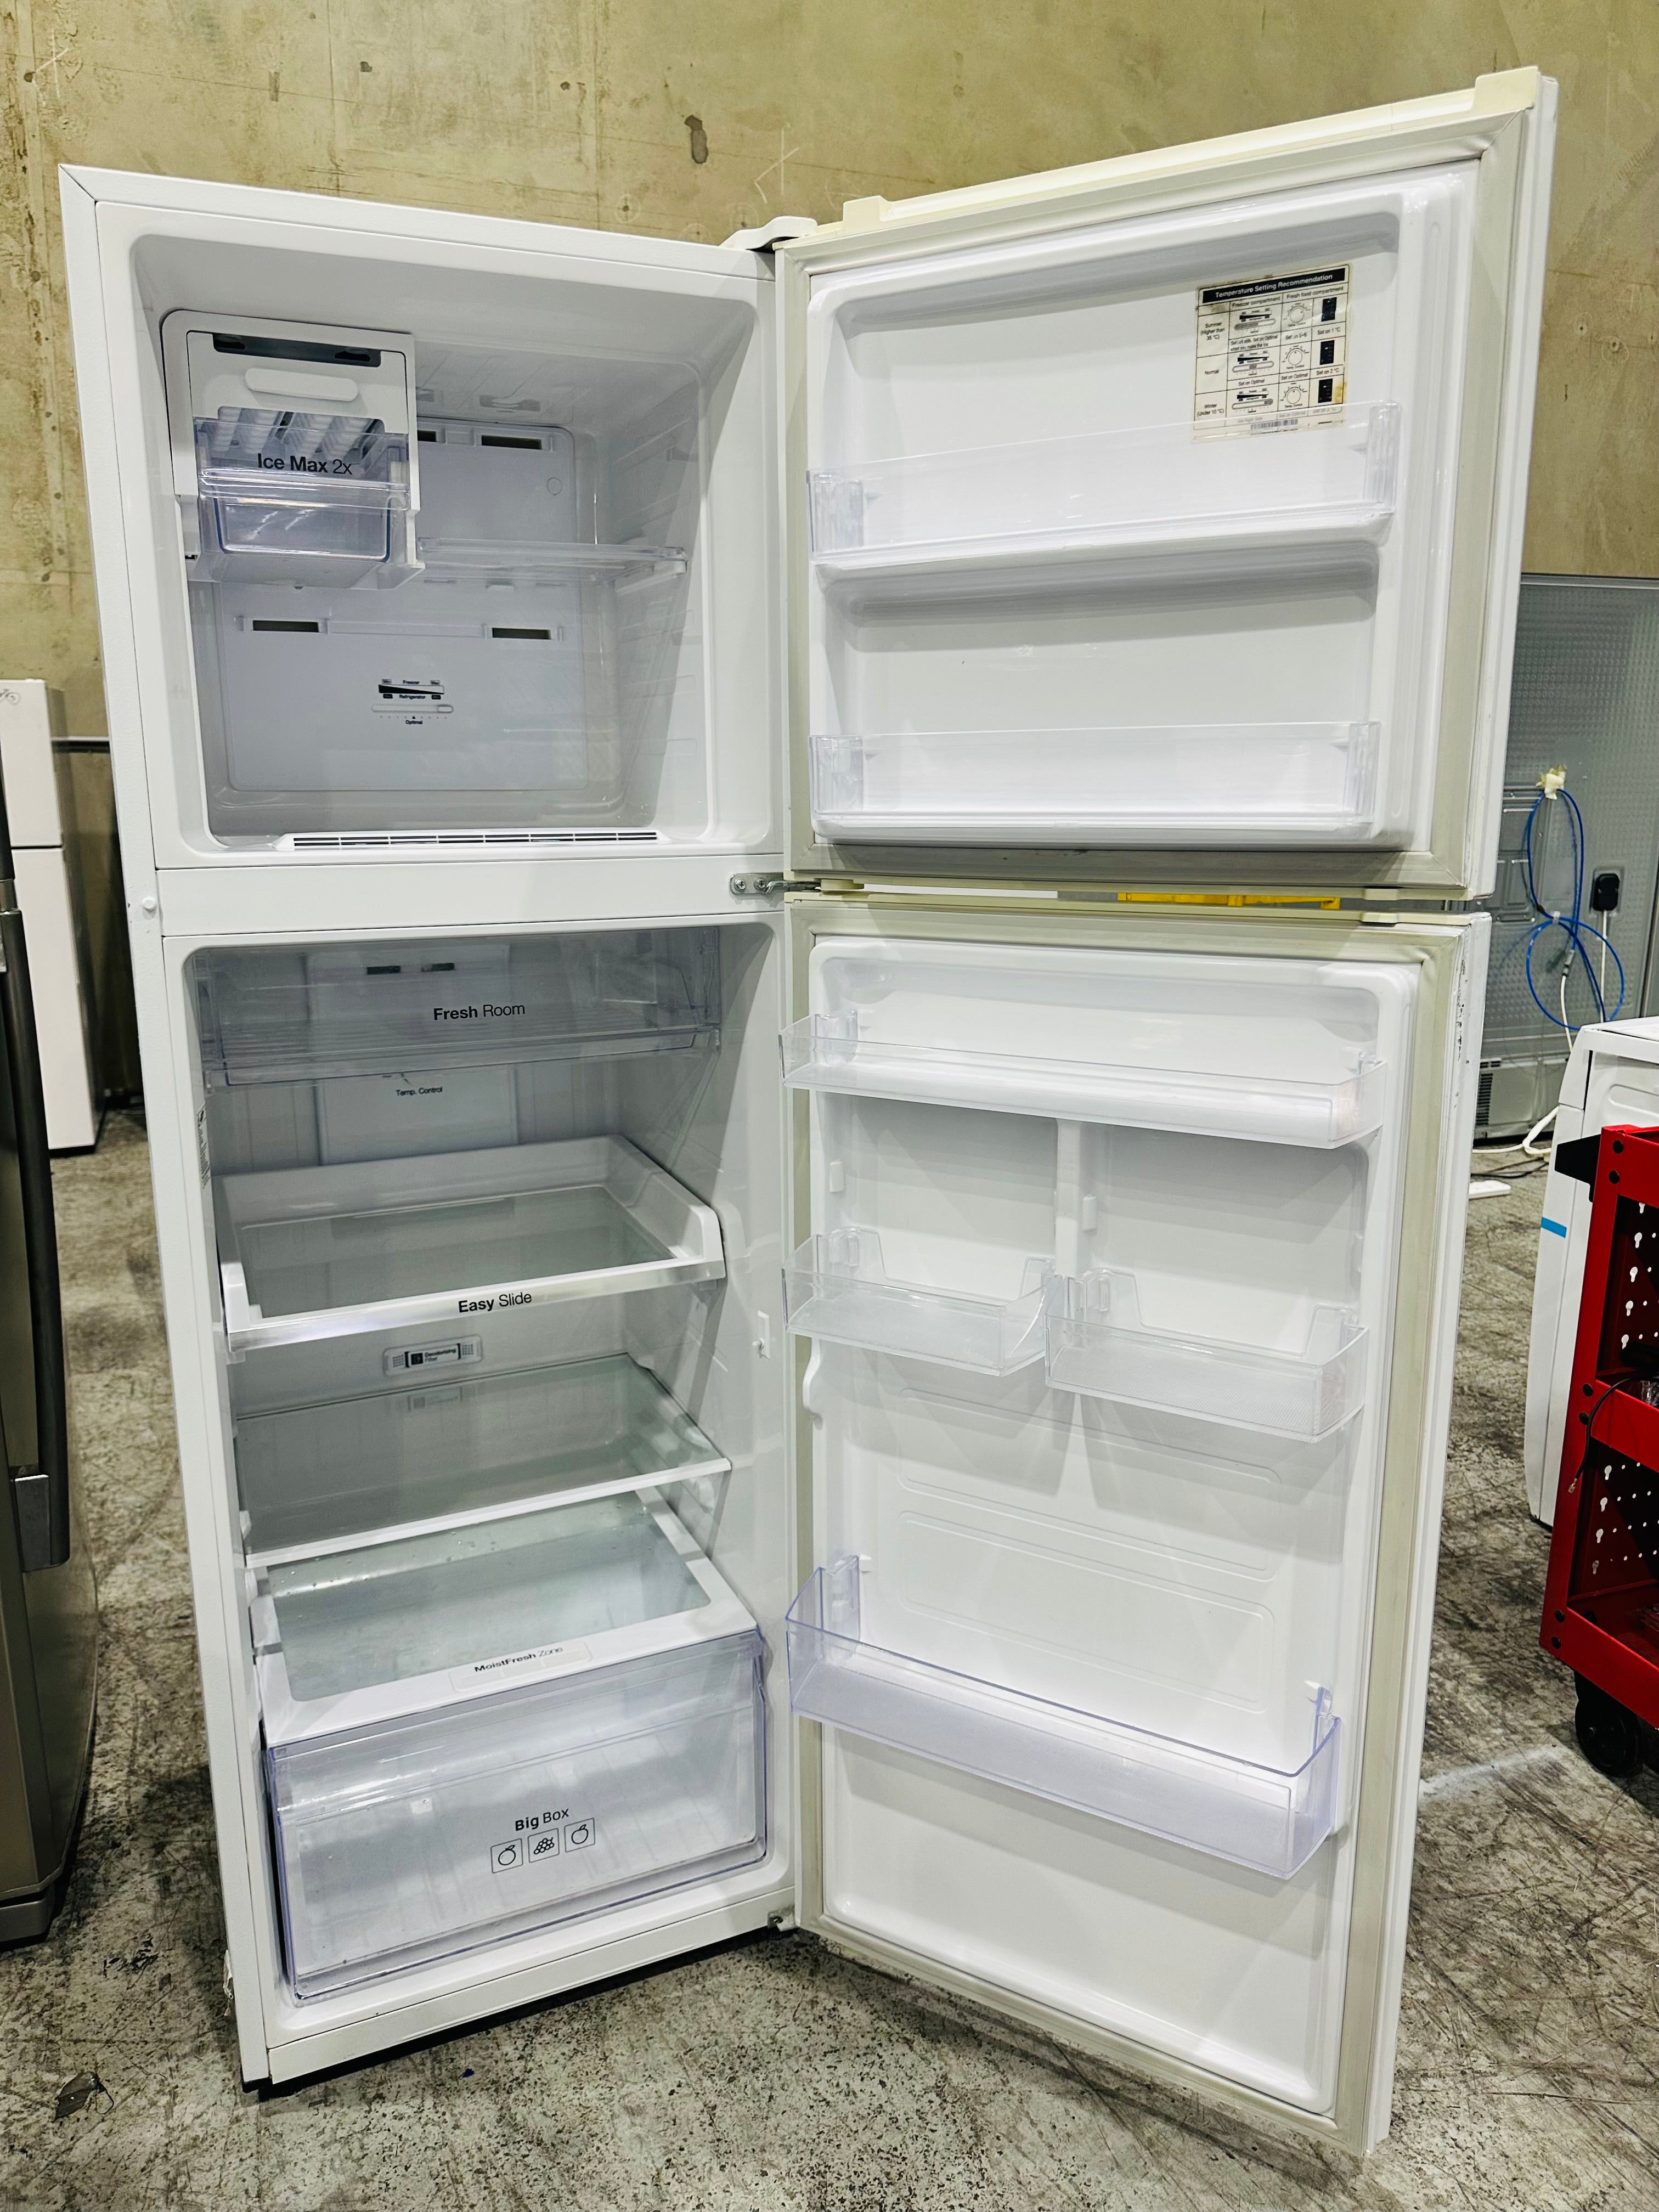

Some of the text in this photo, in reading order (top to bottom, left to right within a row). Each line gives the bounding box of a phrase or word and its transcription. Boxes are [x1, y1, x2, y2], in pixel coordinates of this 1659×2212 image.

[1215, 274, 1333, 298] Temperature Setting Recommendation
[1312, 286, 1344, 296] compartment
[1250, 296, 1280, 306] compartment
[258, 453, 352, 475] Ice Max 2x
[433, 1004, 525, 1020] Fresh Room
[396, 1086, 443, 1097] Temp. Control
[458, 1292, 532, 1313] Easy Slide
[474, 1647, 563, 1672] MoistFresh Zone
[515, 1808, 569, 1831] Big Box
